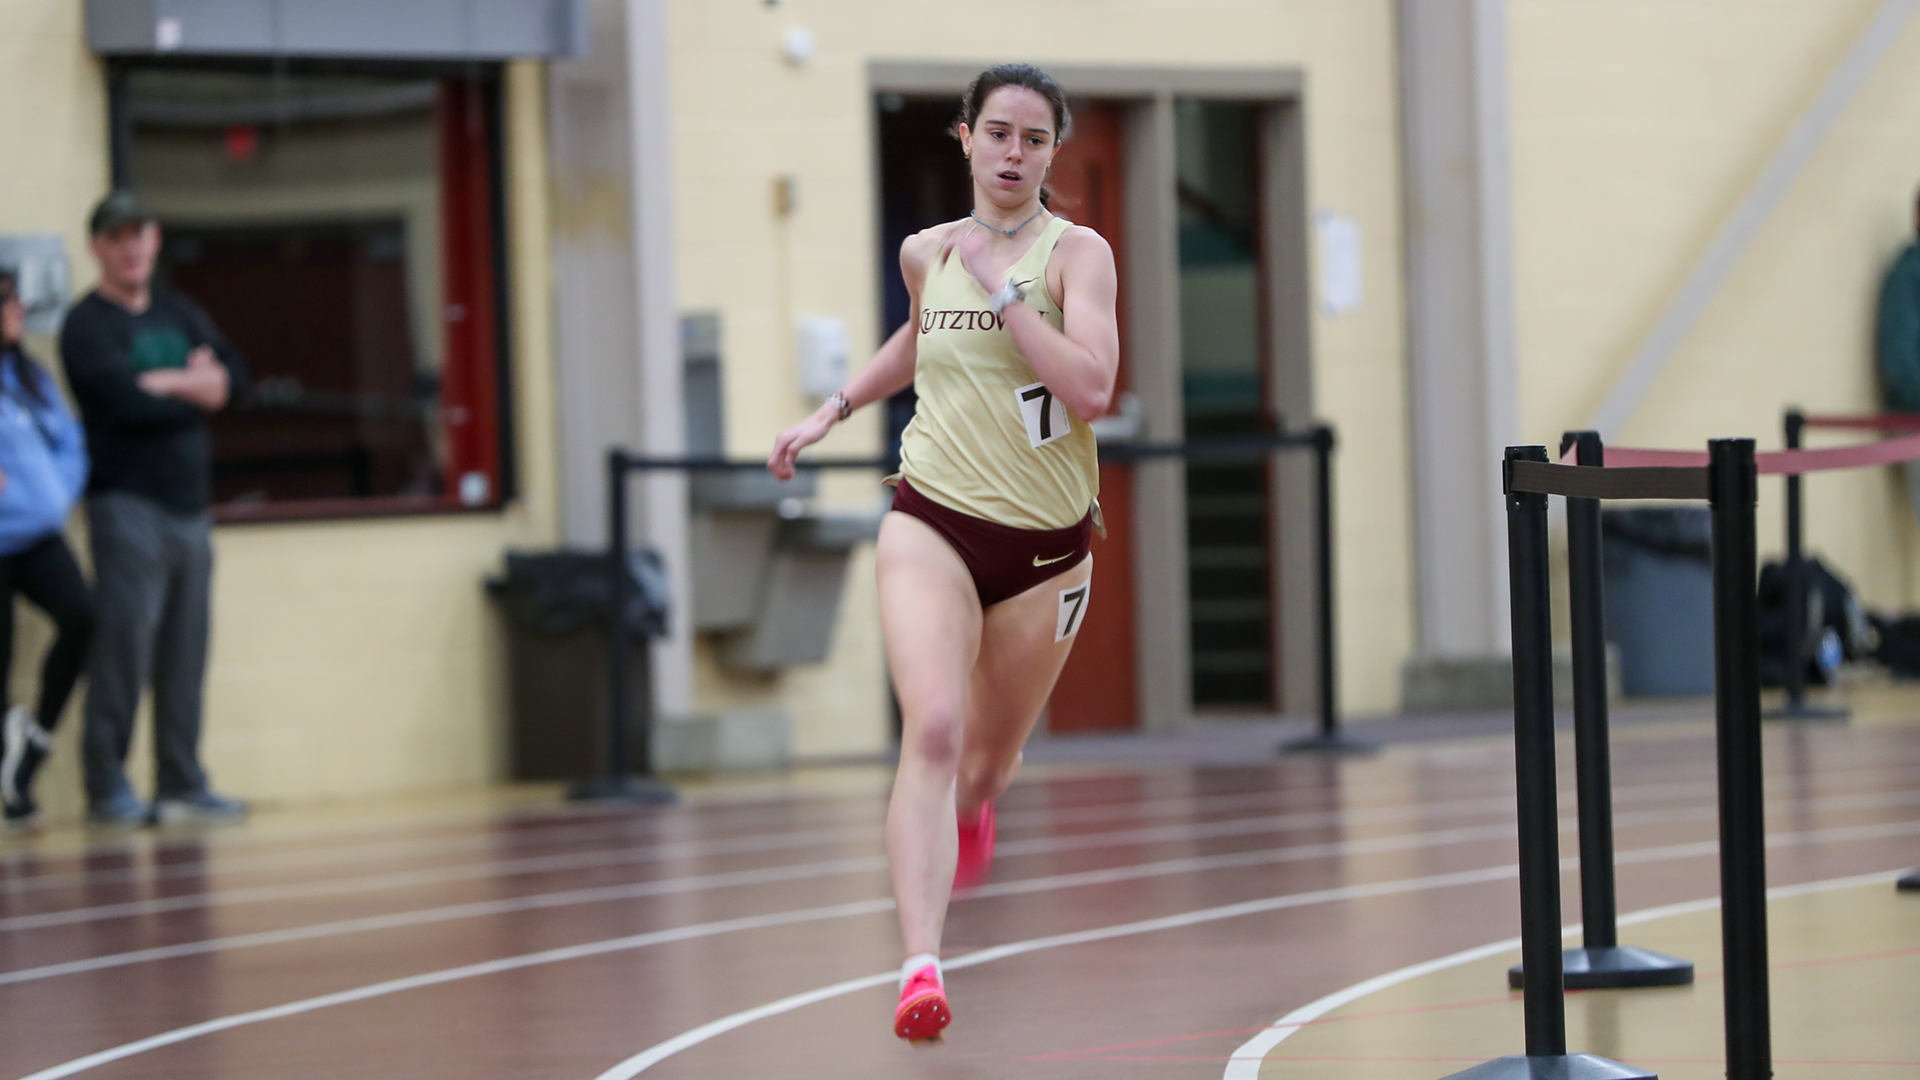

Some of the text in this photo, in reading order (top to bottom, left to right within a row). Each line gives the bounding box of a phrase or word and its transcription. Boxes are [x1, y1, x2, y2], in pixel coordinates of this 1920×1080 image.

[919, 308, 1050, 335] UTZTO
[1021, 385, 1053, 441] 7
[1063, 585, 1087, 637] 7
